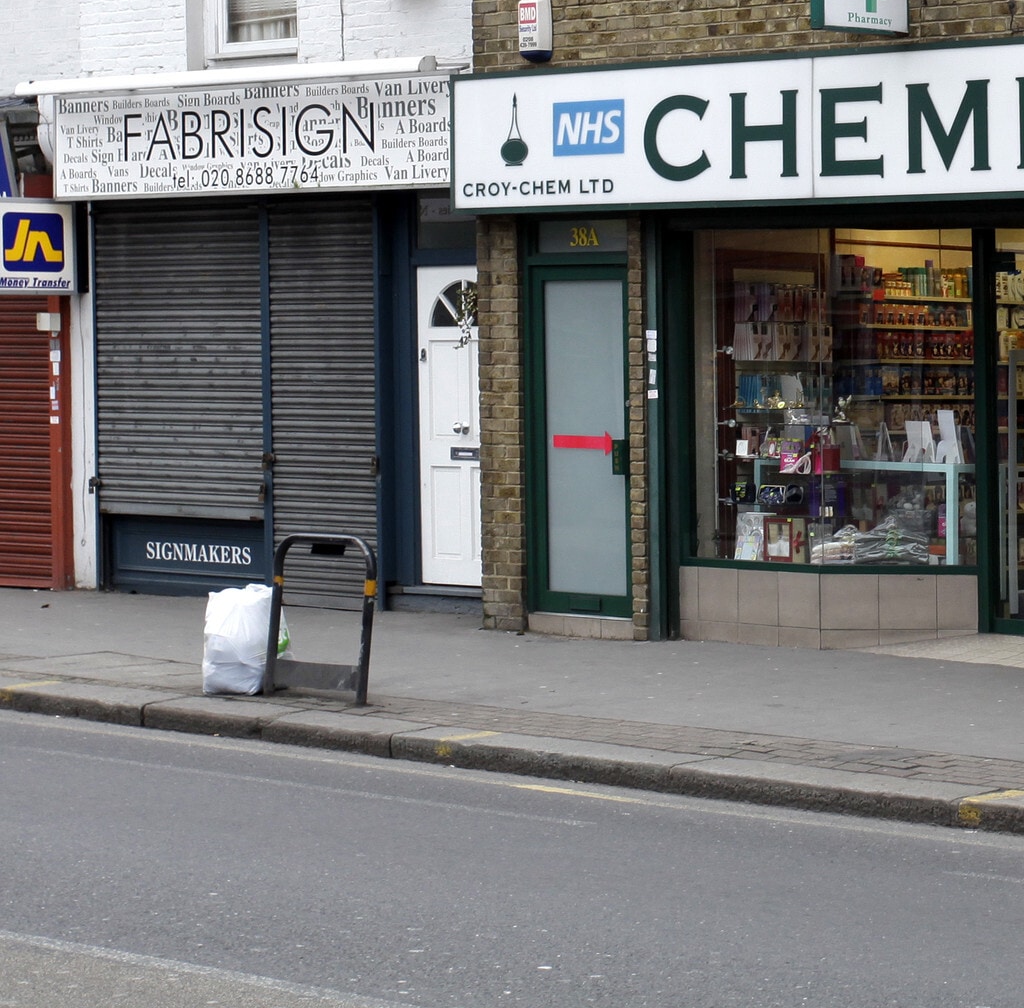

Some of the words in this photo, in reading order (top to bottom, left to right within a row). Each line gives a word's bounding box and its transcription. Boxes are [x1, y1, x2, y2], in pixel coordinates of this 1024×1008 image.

[847, 11, 893, 27] Pharmacy
[59, 98, 110, 114] Banners
[112, 99, 143, 110] Builders
[144, 97, 170, 108] Boards
[177, 93, 200, 108] Sign
[203, 91, 241, 106] Boards
[244, 84, 300, 100] Banners
[305, 86, 339, 97] Builders
[341, 83, 370, 95] Boards
[375, 81, 403, 96] Van
[407, 78, 451, 98] Livery
[355, 96, 437, 119] Bnners
[60, 124, 75, 135] Van
[77, 123, 99, 136] Livery
[123, 102, 376, 162] FABRISIGN
[395, 118, 405, 134] A
[409, 116, 451, 134] Boards
[556, 109, 622, 146] NHS
[67, 136, 74, 148] T
[76, 134, 104, 149] Shirts
[381, 138, 416, 150] Builders
[418, 135, 448, 148] Boards
[63, 152, 88, 164] Decals
[91, 148, 114, 167] Sign
[360, 155, 390, 167] Decals
[405, 149, 415, 163] A
[60, 169, 67, 180] A
[69, 167, 97, 180] Boards
[108, 165, 129, 178] Vans
[172, 169, 195, 189] tel:
[201, 168, 230, 188] 020
[235, 166, 274, 186] 8688
[280, 164, 320, 184] 7764
[337, 169, 378, 184] Graphics
[385, 165, 408, 180] Van
[411, 164, 450, 182] Livery
[64, 183, 69, 193] T
[69, 182, 90, 193] Shirts
[91, 179, 138, 193] Banners
[143, 182, 174, 193] Builders
[462, 180, 571, 197] CROY-CHEM
[579, 179, 614, 194] LTD
[569, 226, 600, 247] 38A
[0, 277, 30, 289] Money
[33, 277, 71, 289] Transfer
[146, 541, 252, 565] SIGNMAKERS
